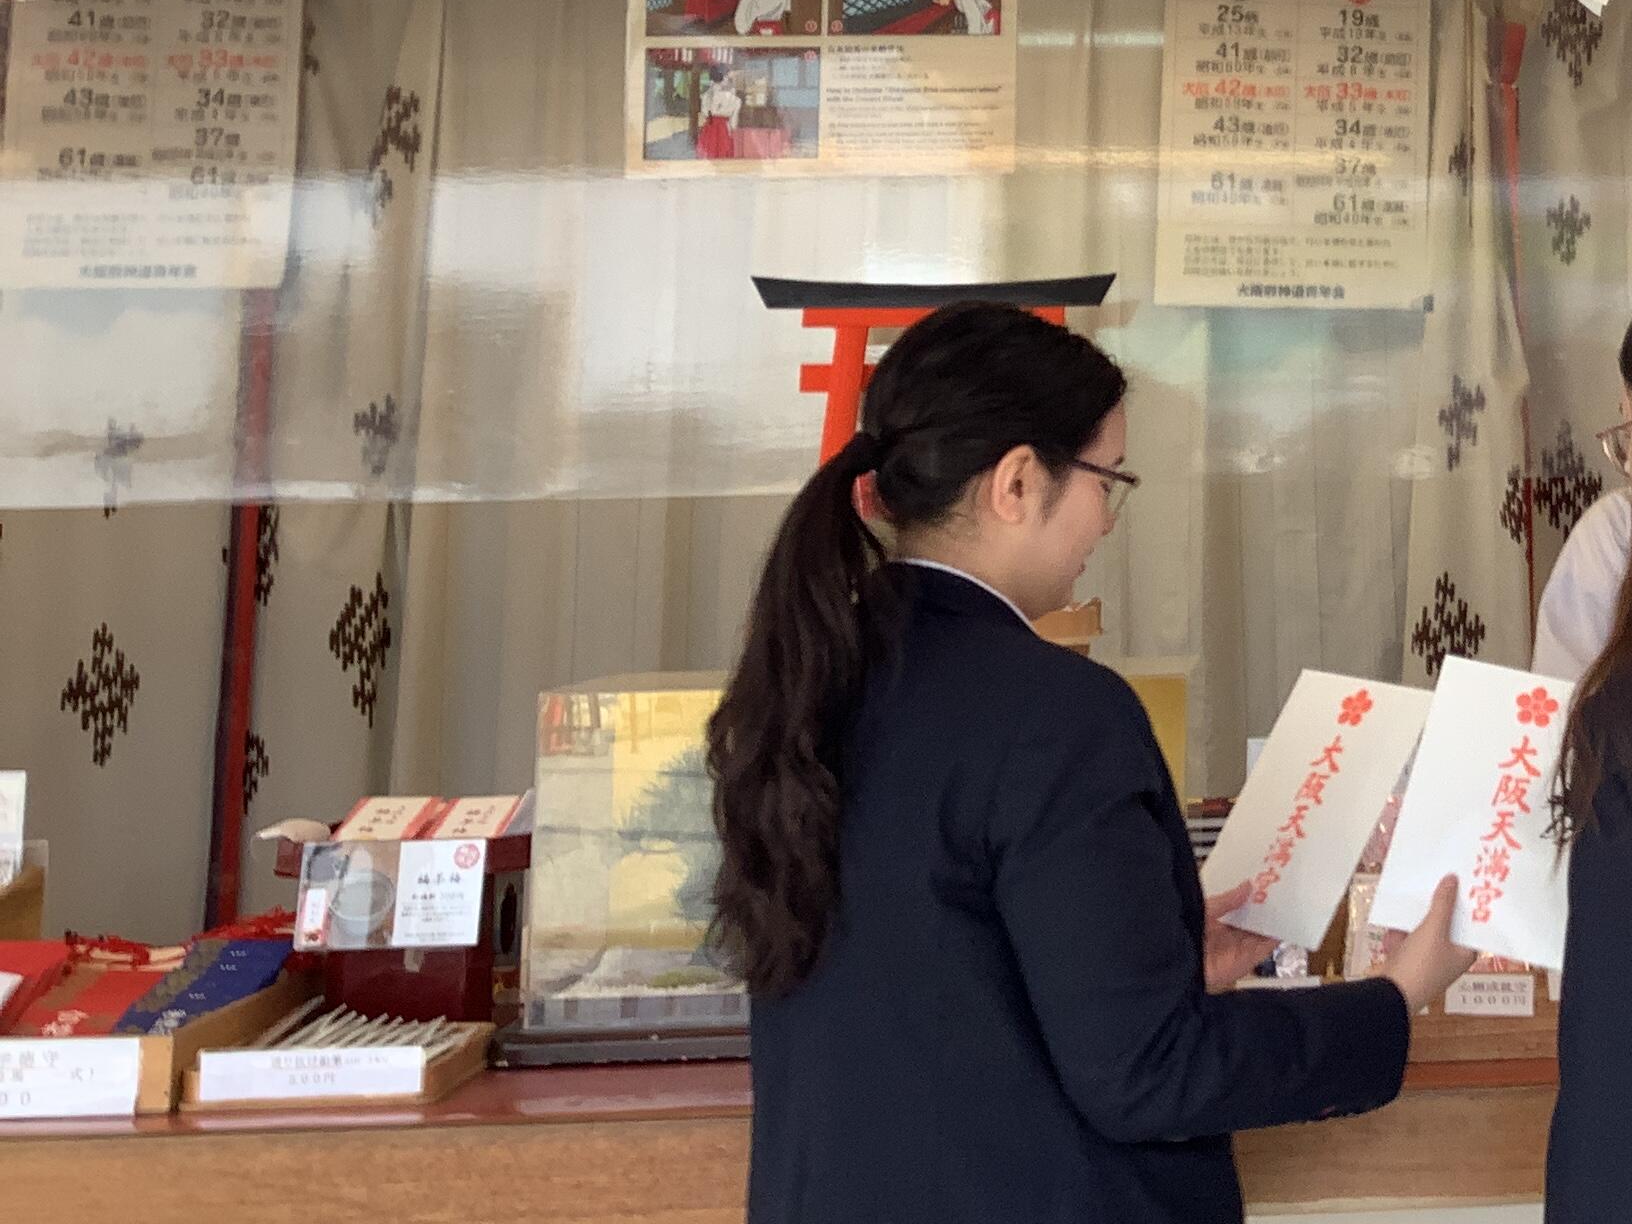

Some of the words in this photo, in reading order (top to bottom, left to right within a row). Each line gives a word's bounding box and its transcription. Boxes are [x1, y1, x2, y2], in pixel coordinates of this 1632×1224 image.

[1470, 735, 1541, 924] 大阪天満宮
